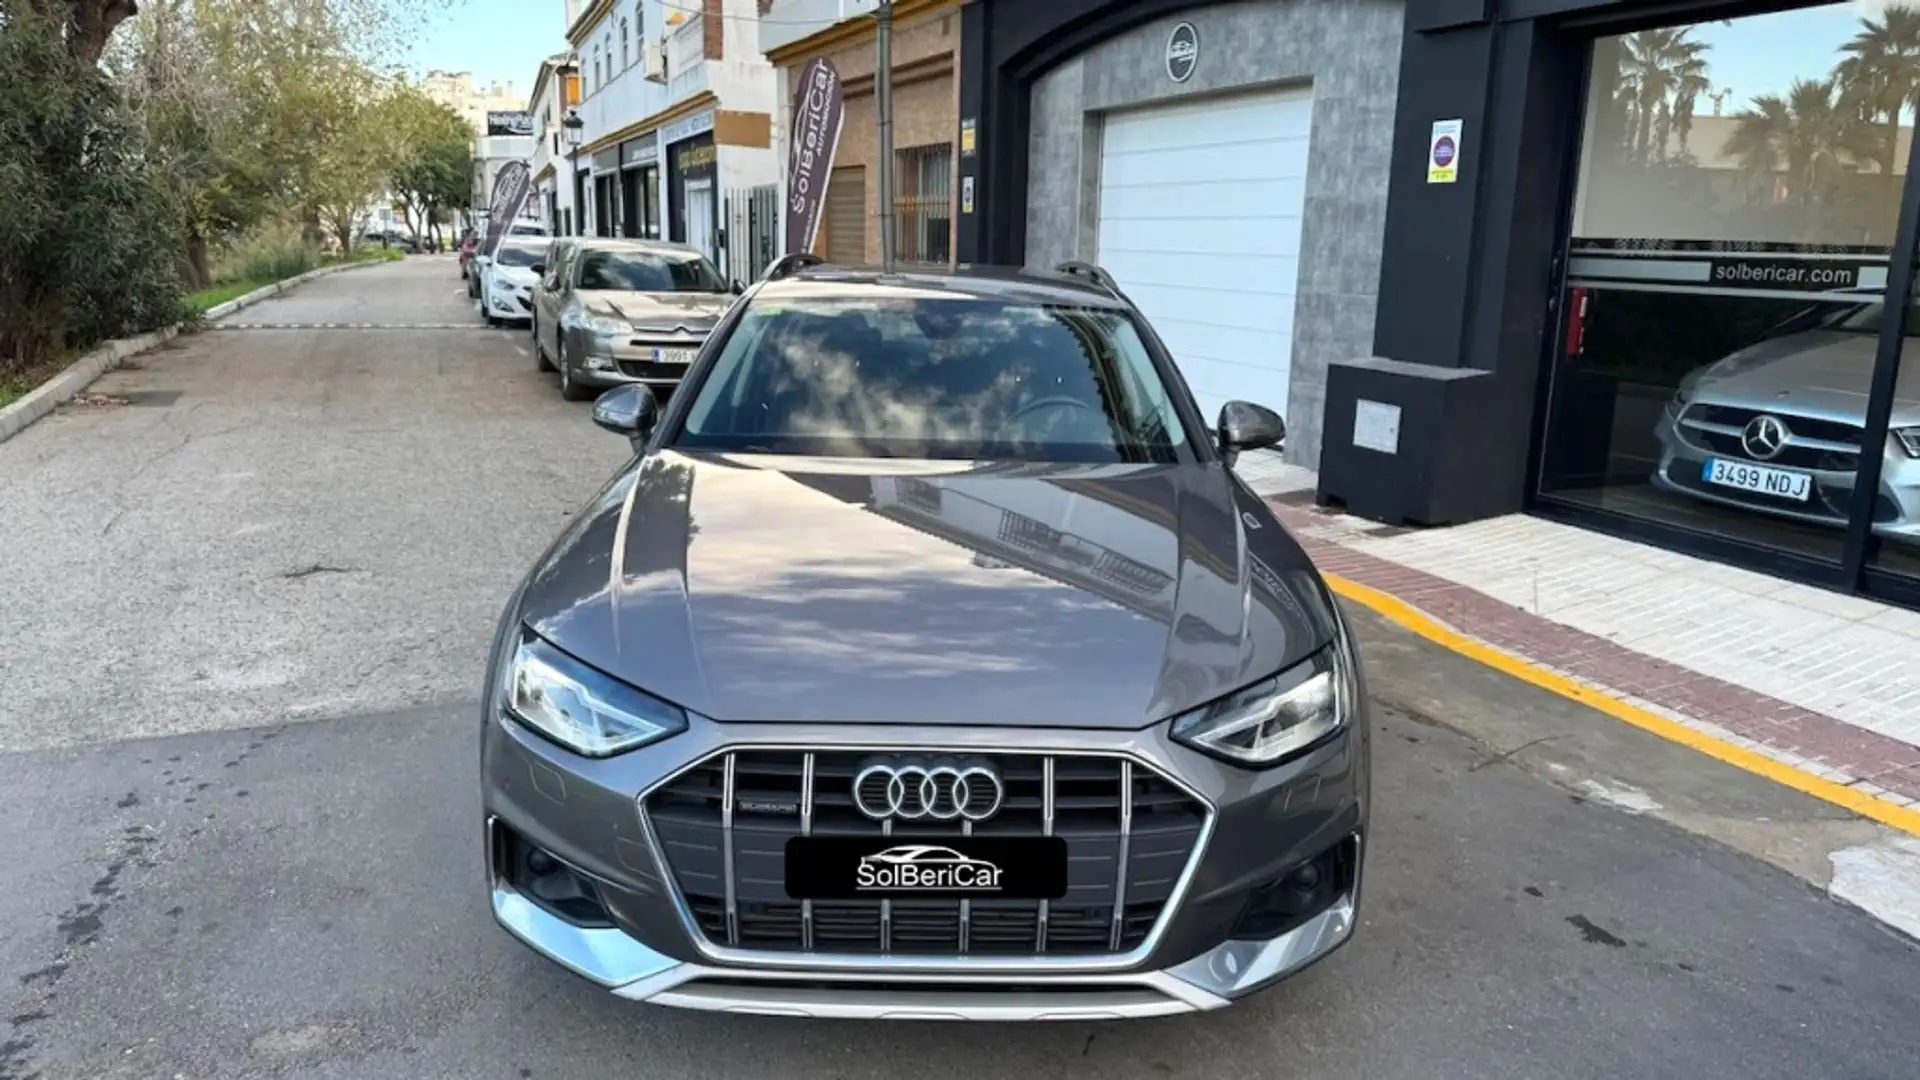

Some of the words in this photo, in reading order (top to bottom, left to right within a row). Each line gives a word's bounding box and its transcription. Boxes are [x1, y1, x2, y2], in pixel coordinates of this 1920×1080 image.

[791, 60, 829, 215] SolBeriCar
[1715, 262, 1852, 285] solbericar.com
[1714, 462, 1760, 490] 3499
[1763, 470, 1807, 497] NDJ
